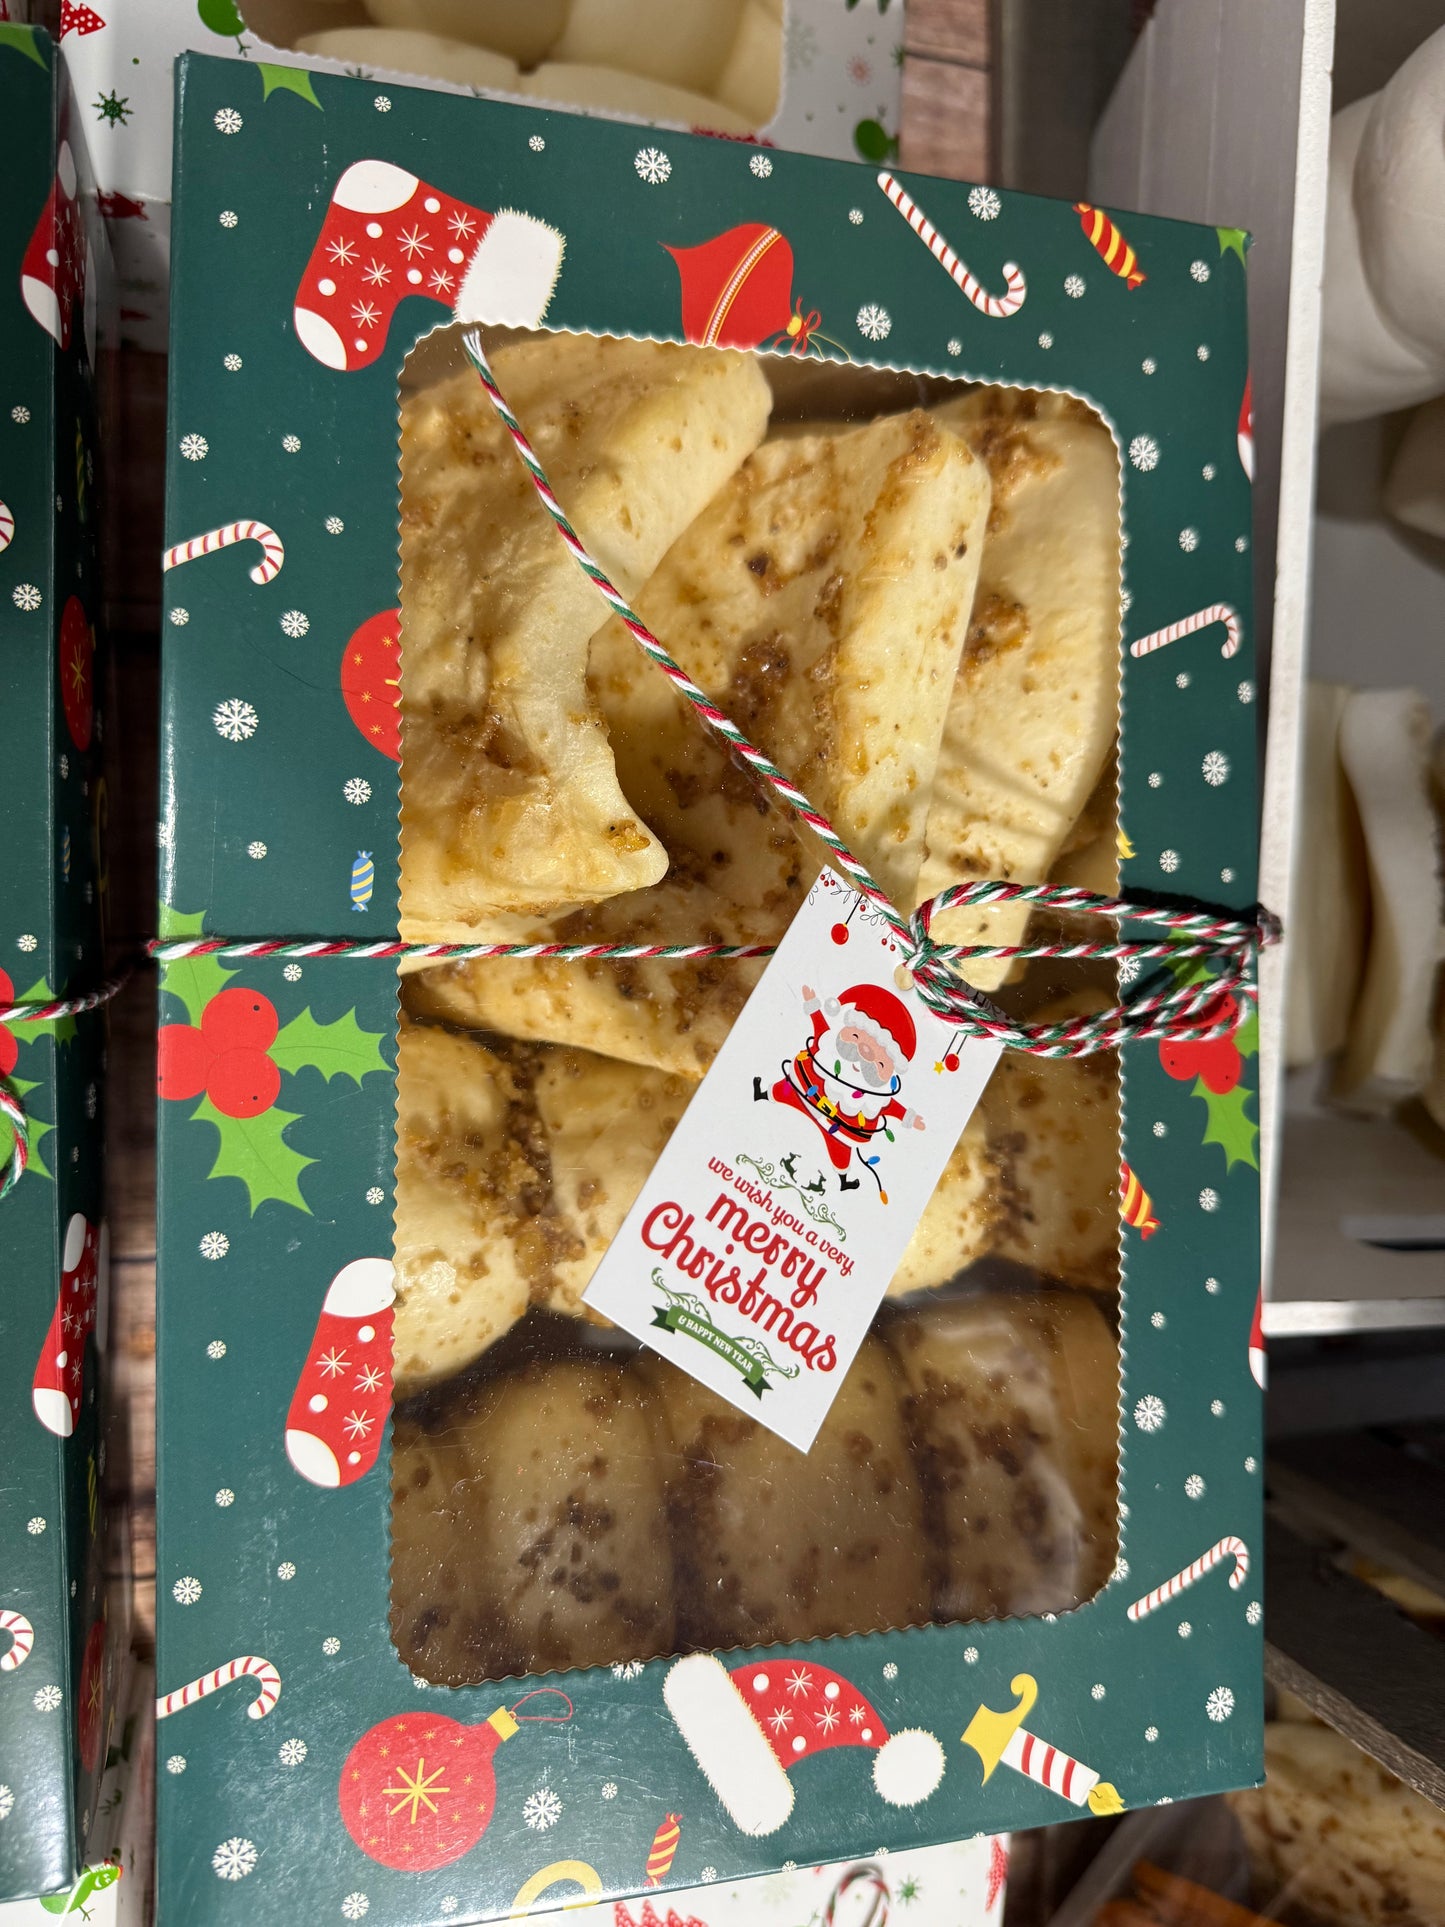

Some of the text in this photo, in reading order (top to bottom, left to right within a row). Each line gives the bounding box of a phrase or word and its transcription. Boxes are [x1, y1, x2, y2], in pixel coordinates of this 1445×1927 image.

[705, 1192, 827, 1309] merry
[707, 1156, 855, 1277] we wish you a very
[641, 1201, 837, 1372] Christmas
[685, 1318, 716, 1341] HAPPY
[713, 1338, 734, 1354] NEW
[732, 1350, 754, 1373] YEAR
